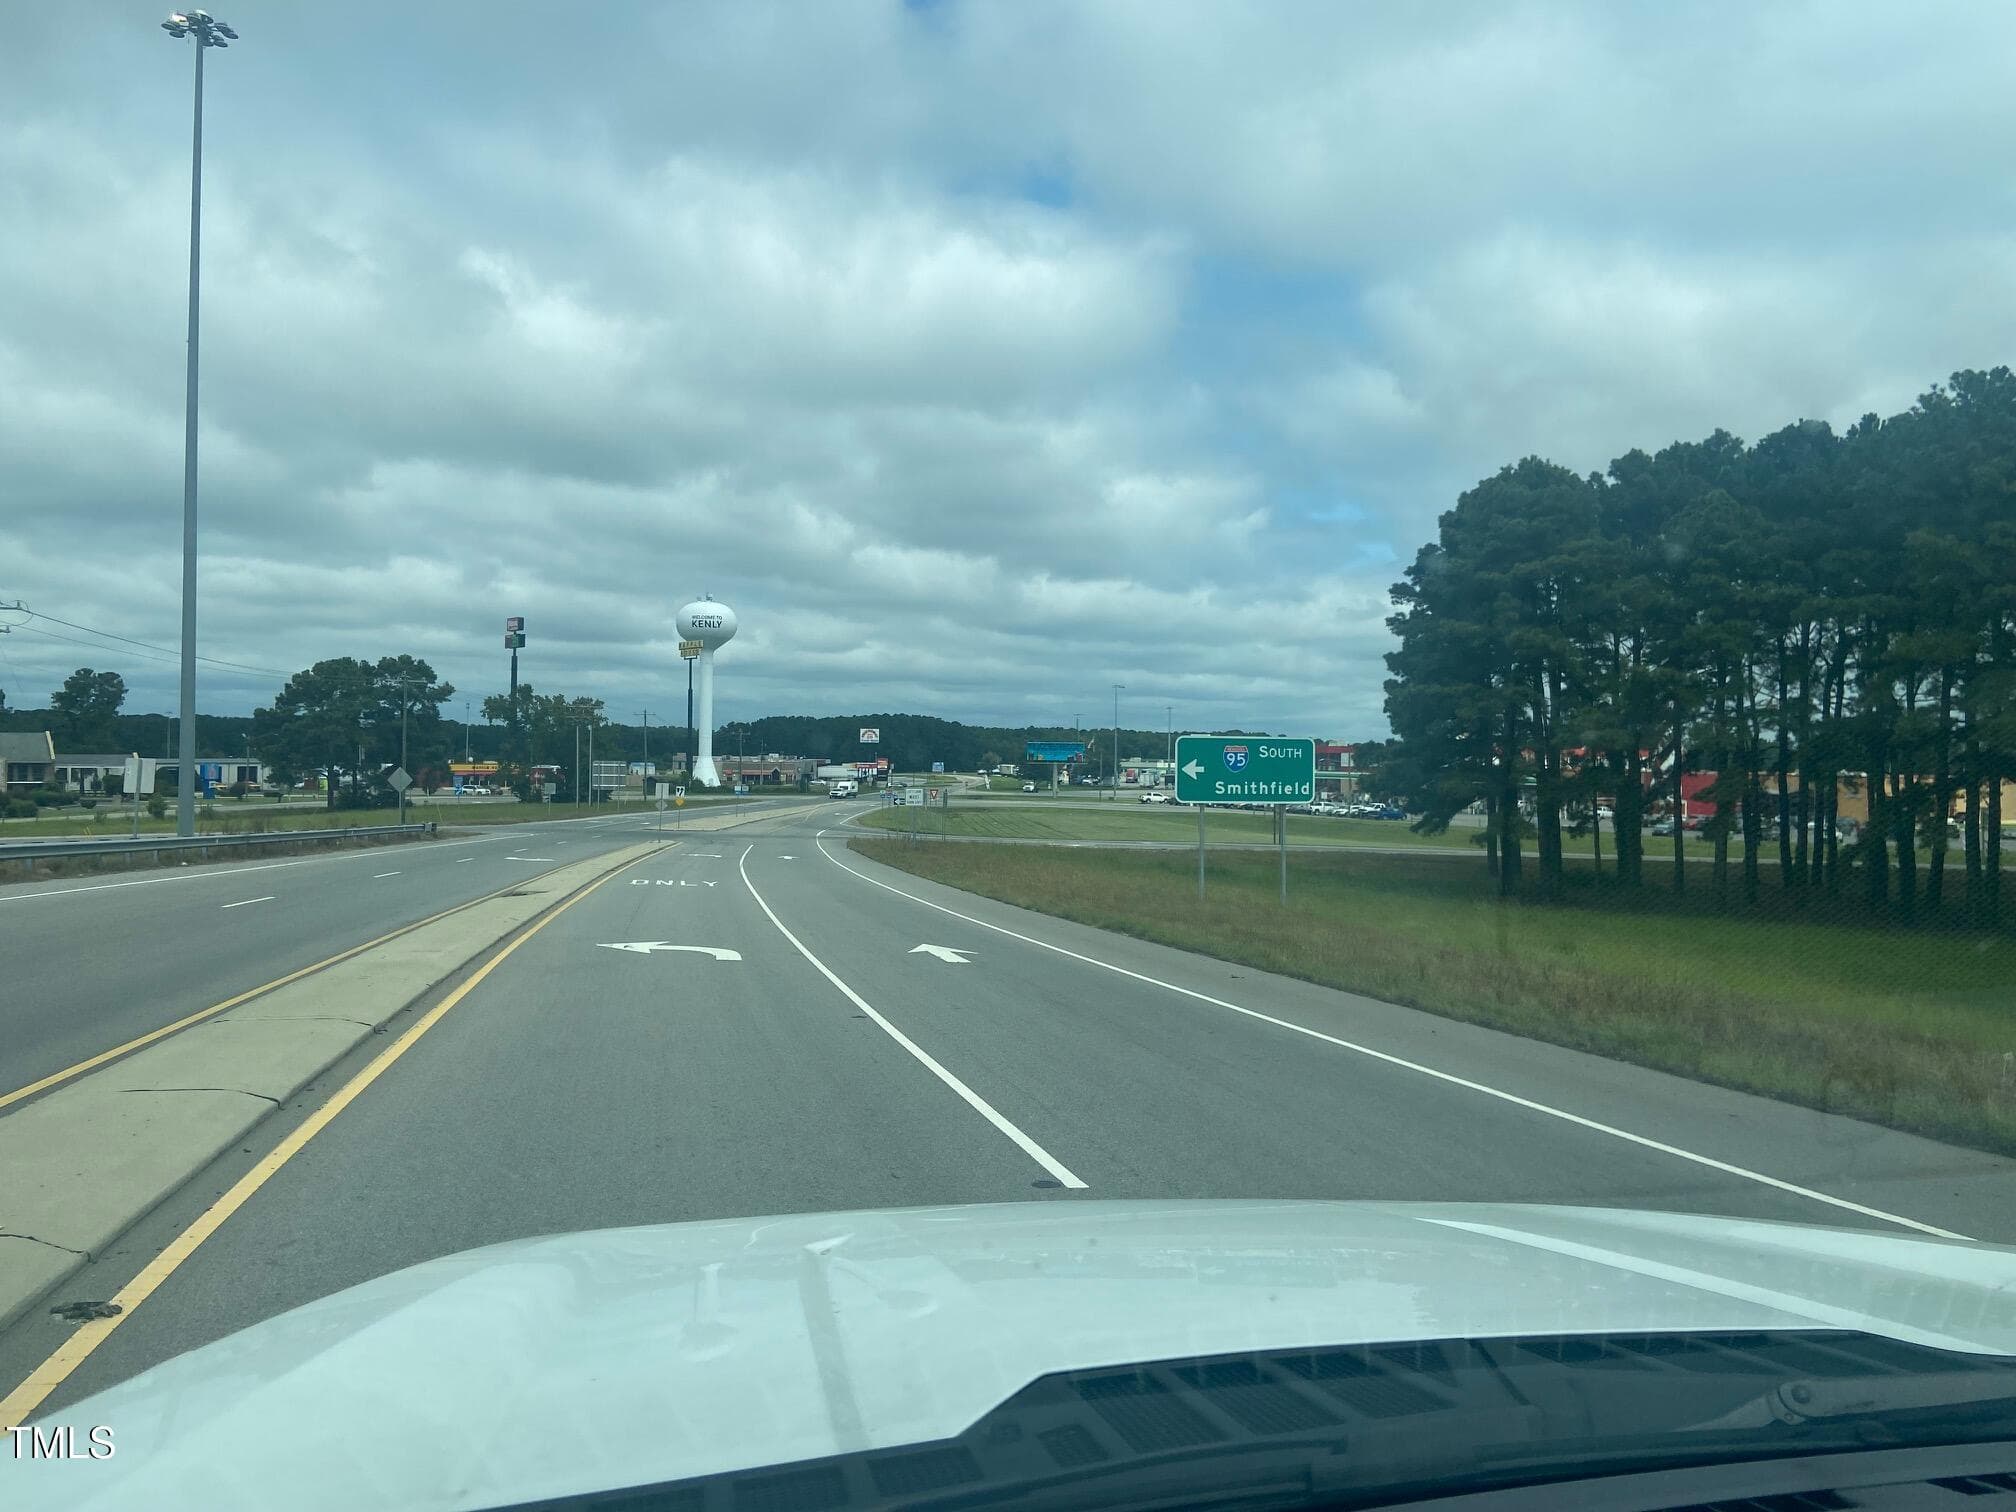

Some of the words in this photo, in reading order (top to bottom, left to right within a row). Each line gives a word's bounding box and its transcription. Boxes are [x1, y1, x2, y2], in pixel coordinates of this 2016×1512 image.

[691, 620, 722, 628] KENLY
[1226, 752, 1246, 767] 95
[1259, 745, 1302, 759] SOUTH
[1214, 780, 1310, 795] Smithfield
[630, 879, 718, 887] ONLY
